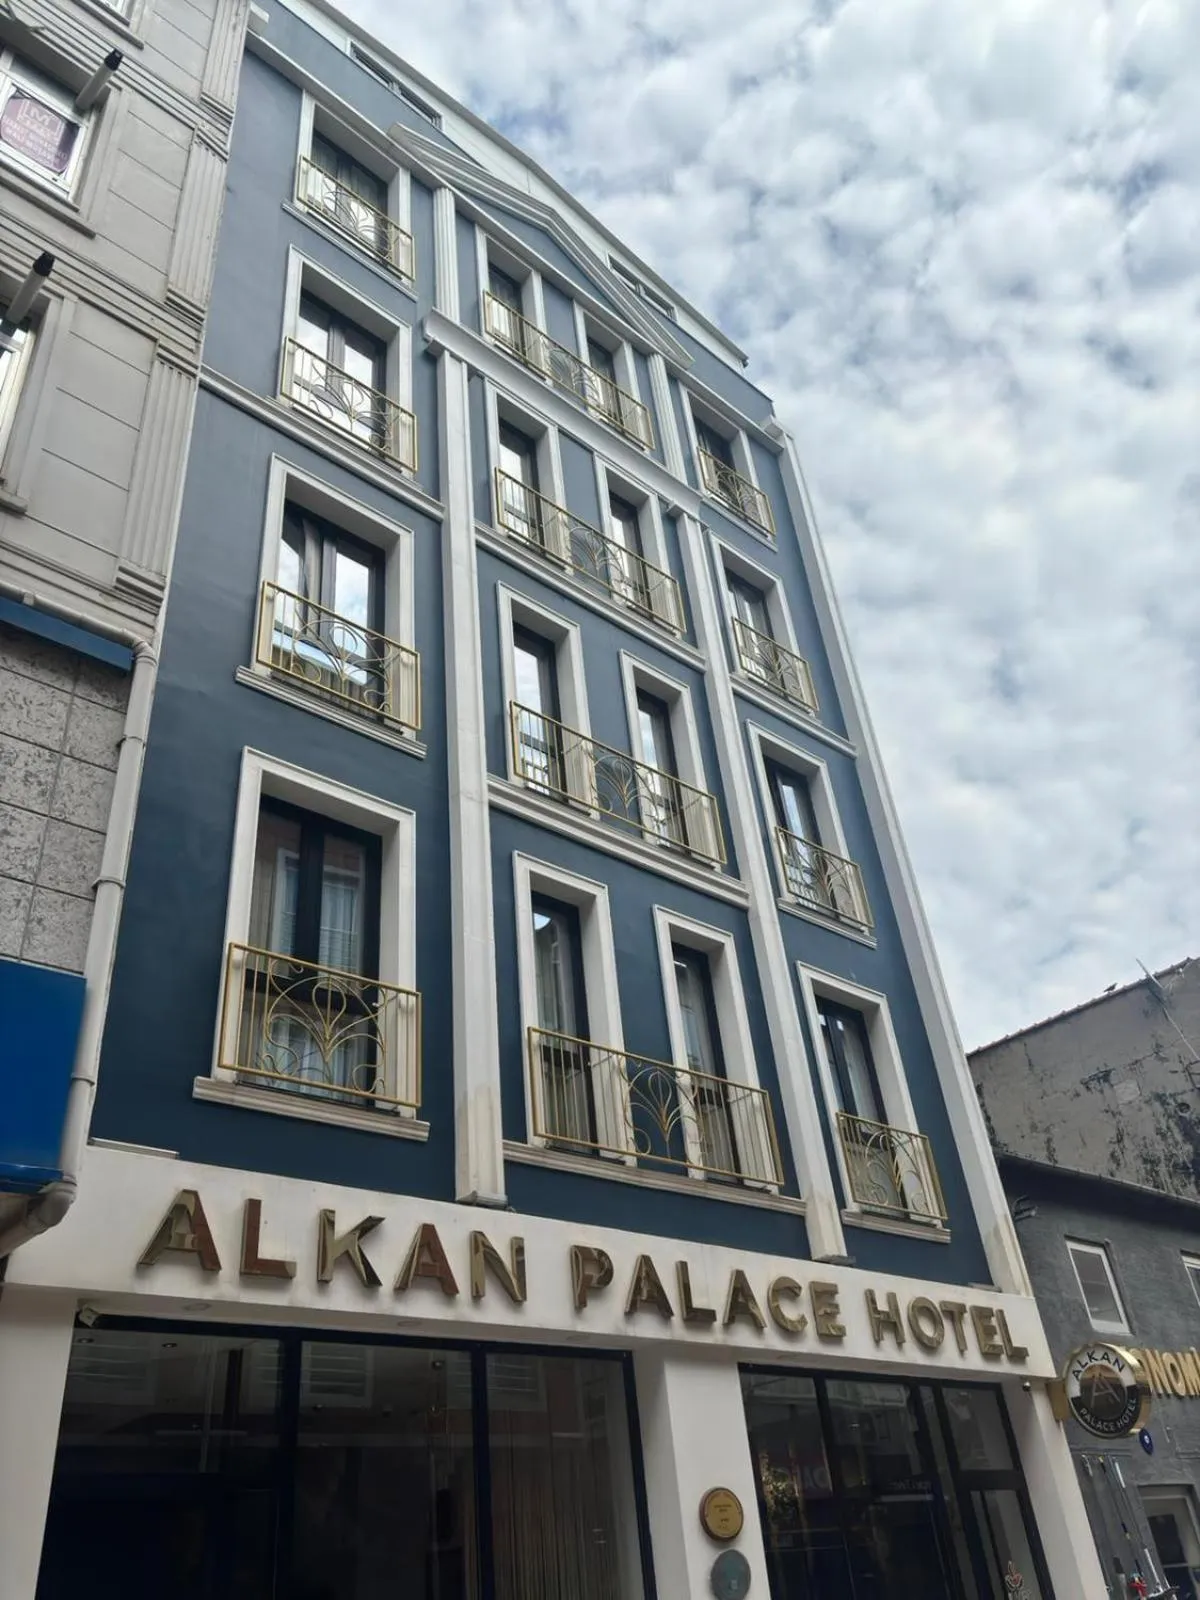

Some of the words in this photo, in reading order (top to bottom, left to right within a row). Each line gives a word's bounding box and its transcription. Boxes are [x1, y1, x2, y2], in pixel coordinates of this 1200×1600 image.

[137, 1189, 527, 1302] ALKAN
[570, 1244, 846, 1338] PALACE
[864, 1288, 1029, 1359] HOTEL
[1072, 1350, 1125, 1381] ALKAN
[1080, 1407, 1115, 1432] PALACE
[1116, 1399, 1137, 1428] HOTEL
